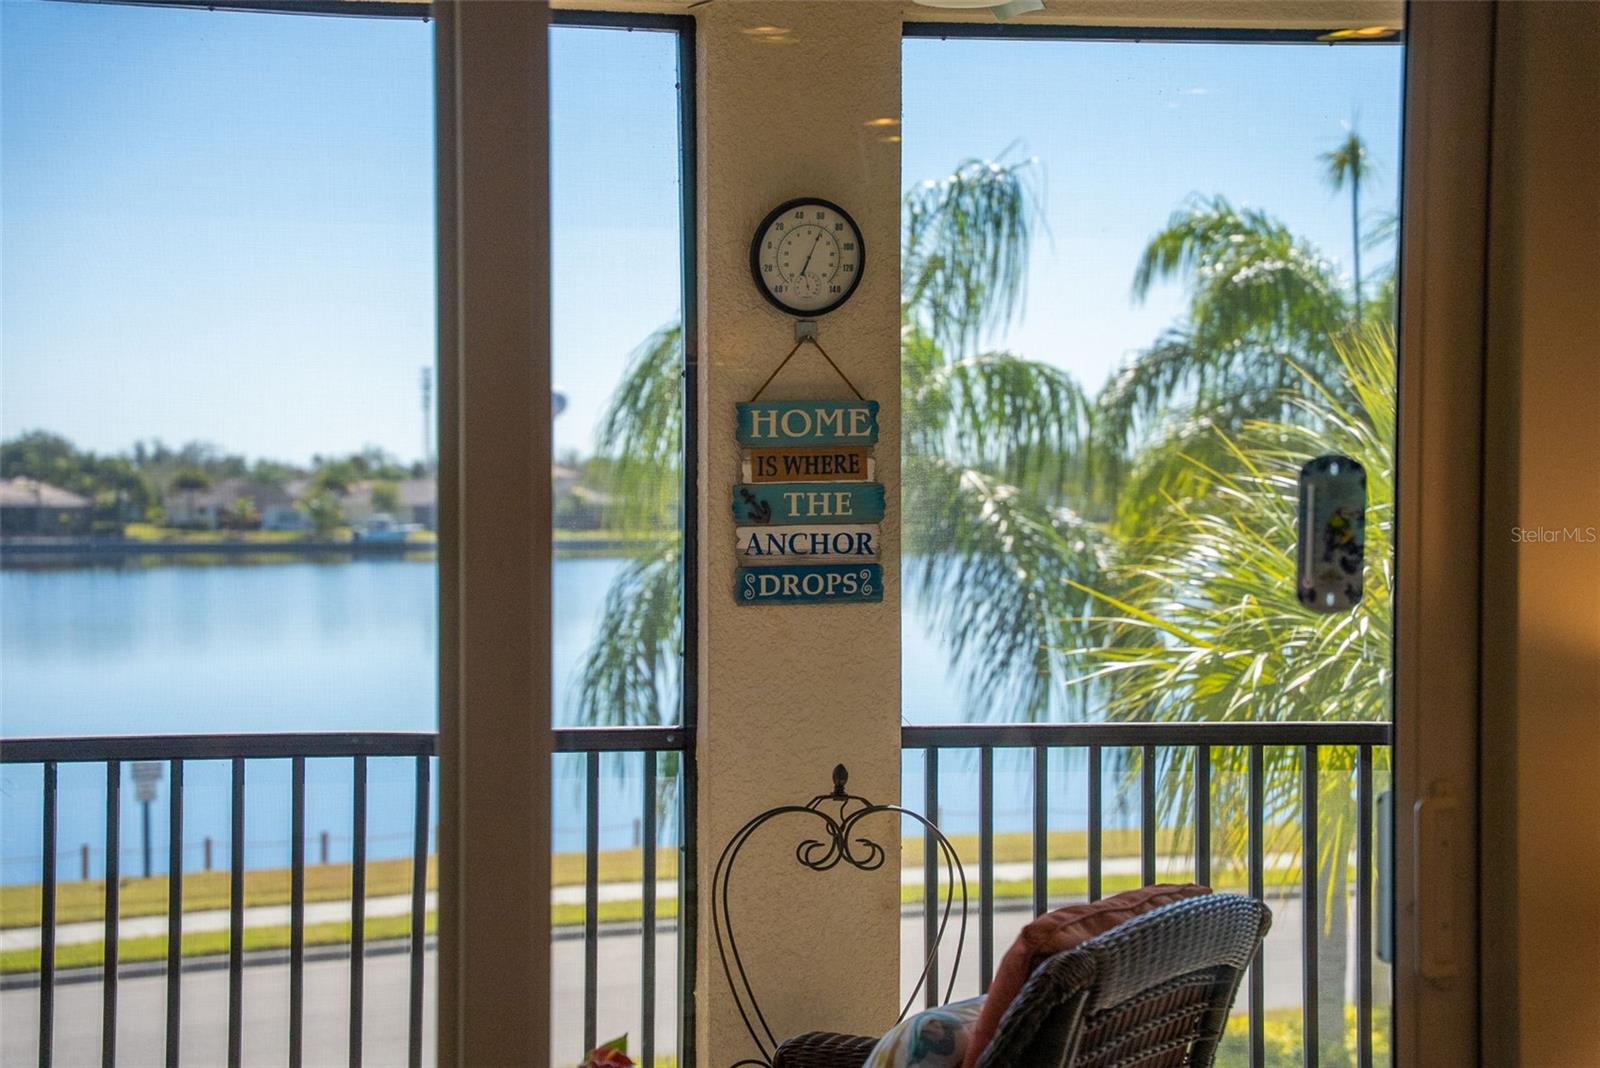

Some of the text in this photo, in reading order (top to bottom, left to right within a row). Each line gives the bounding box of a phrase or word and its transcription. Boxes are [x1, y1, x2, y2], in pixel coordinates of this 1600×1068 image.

[775, 222, 784, 231] 20
[751, 408, 872, 438] HOME
[757, 454, 860, 476] IS WHERE
[783, 492, 853, 516] THE
[744, 532, 875, 556] ANCHOR
[758, 573, 858, 596] DROPS
